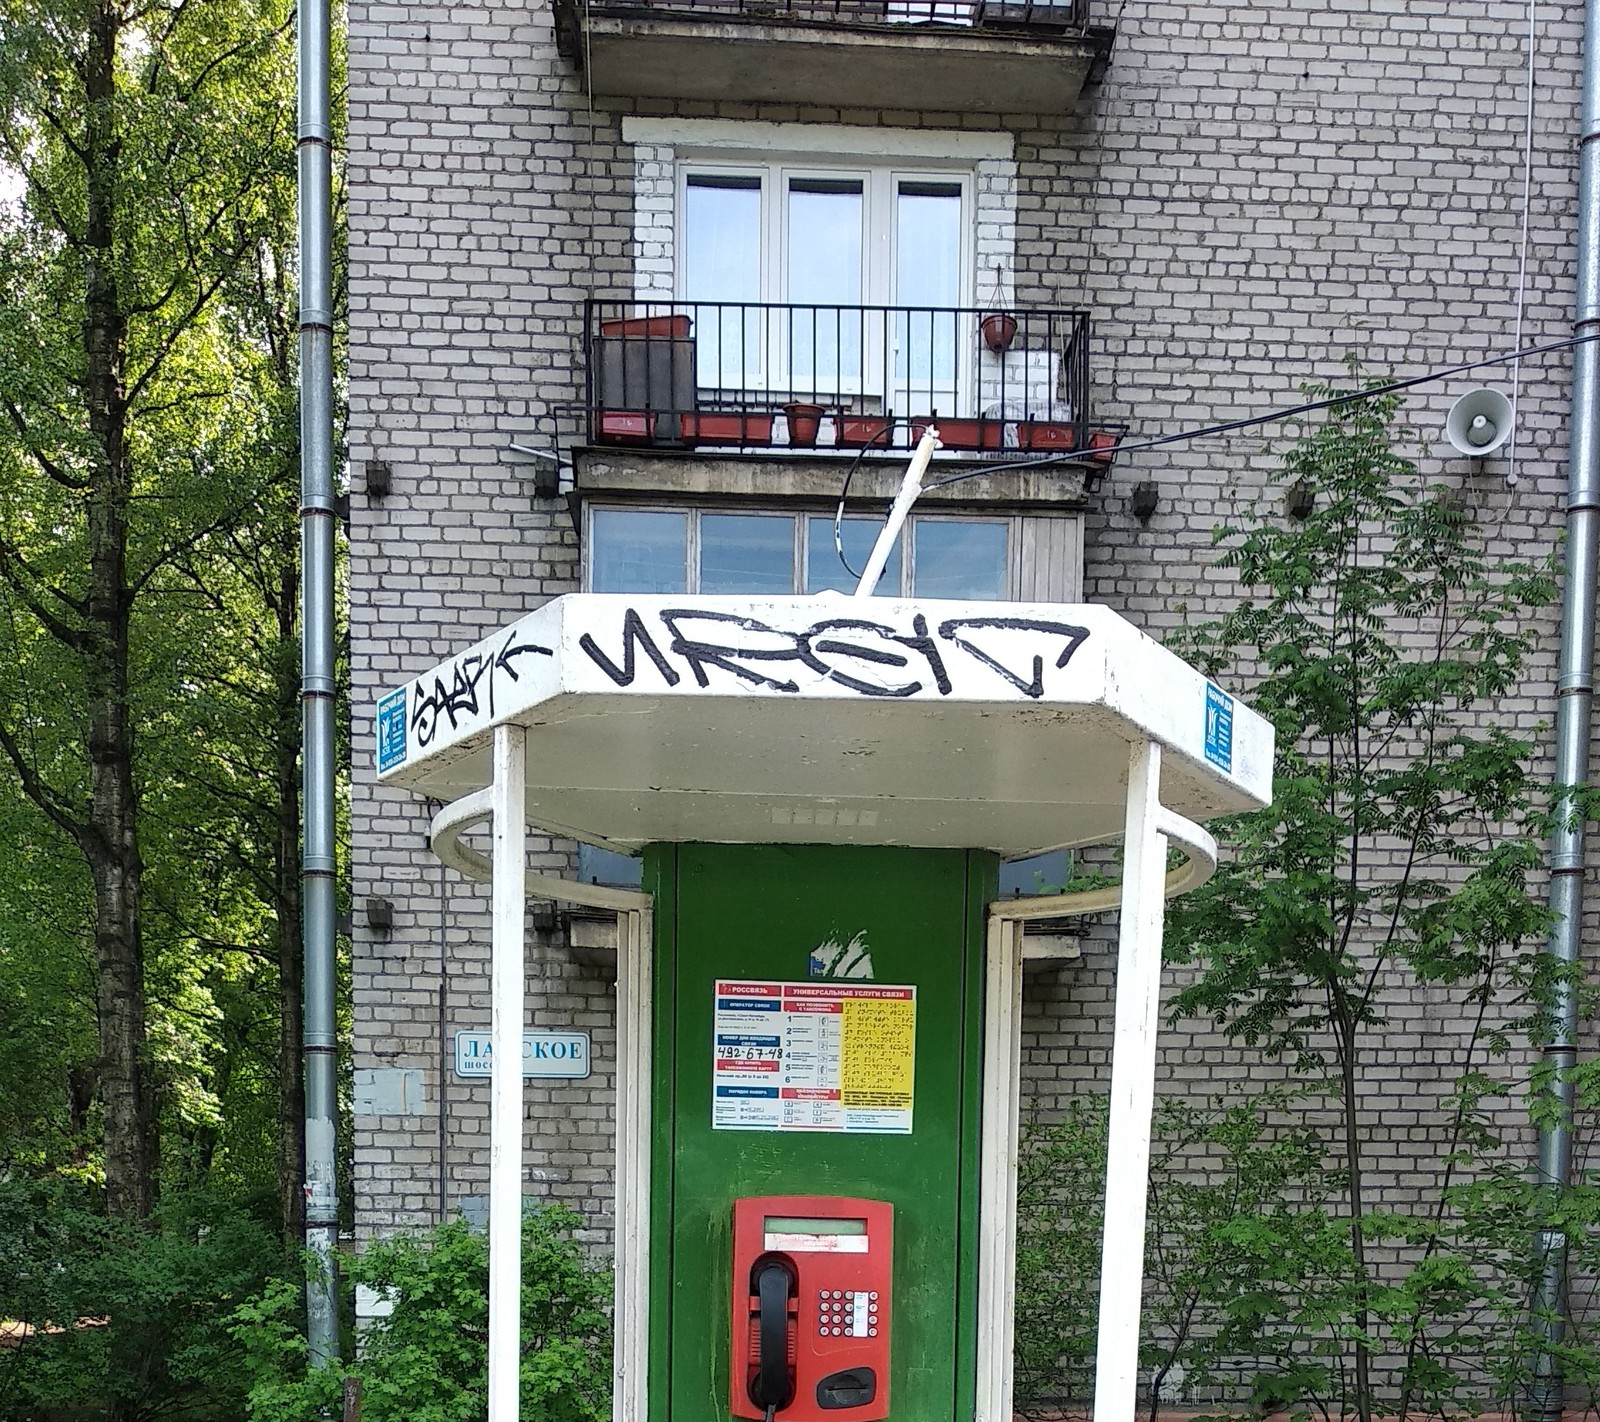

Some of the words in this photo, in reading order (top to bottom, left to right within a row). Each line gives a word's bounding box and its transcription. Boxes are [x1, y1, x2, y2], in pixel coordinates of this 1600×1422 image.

[732, 986, 768, 994] РОССВЯЗЬ
[793, 988, 853, 997] УНИВЕРСАЛЬНЫЕ
[787, 1015, 792, 1023] 1
[786, 1039, 792, 1047] 3
[464, 1040, 583, 1059] ЛАСКОЕ
[717, 1046, 783, 1060] 492-67-48
[785, 1051, 791, 1059] 4
[785, 1063, 791, 1071] 5
[785, 1076, 791, 1084] 6
